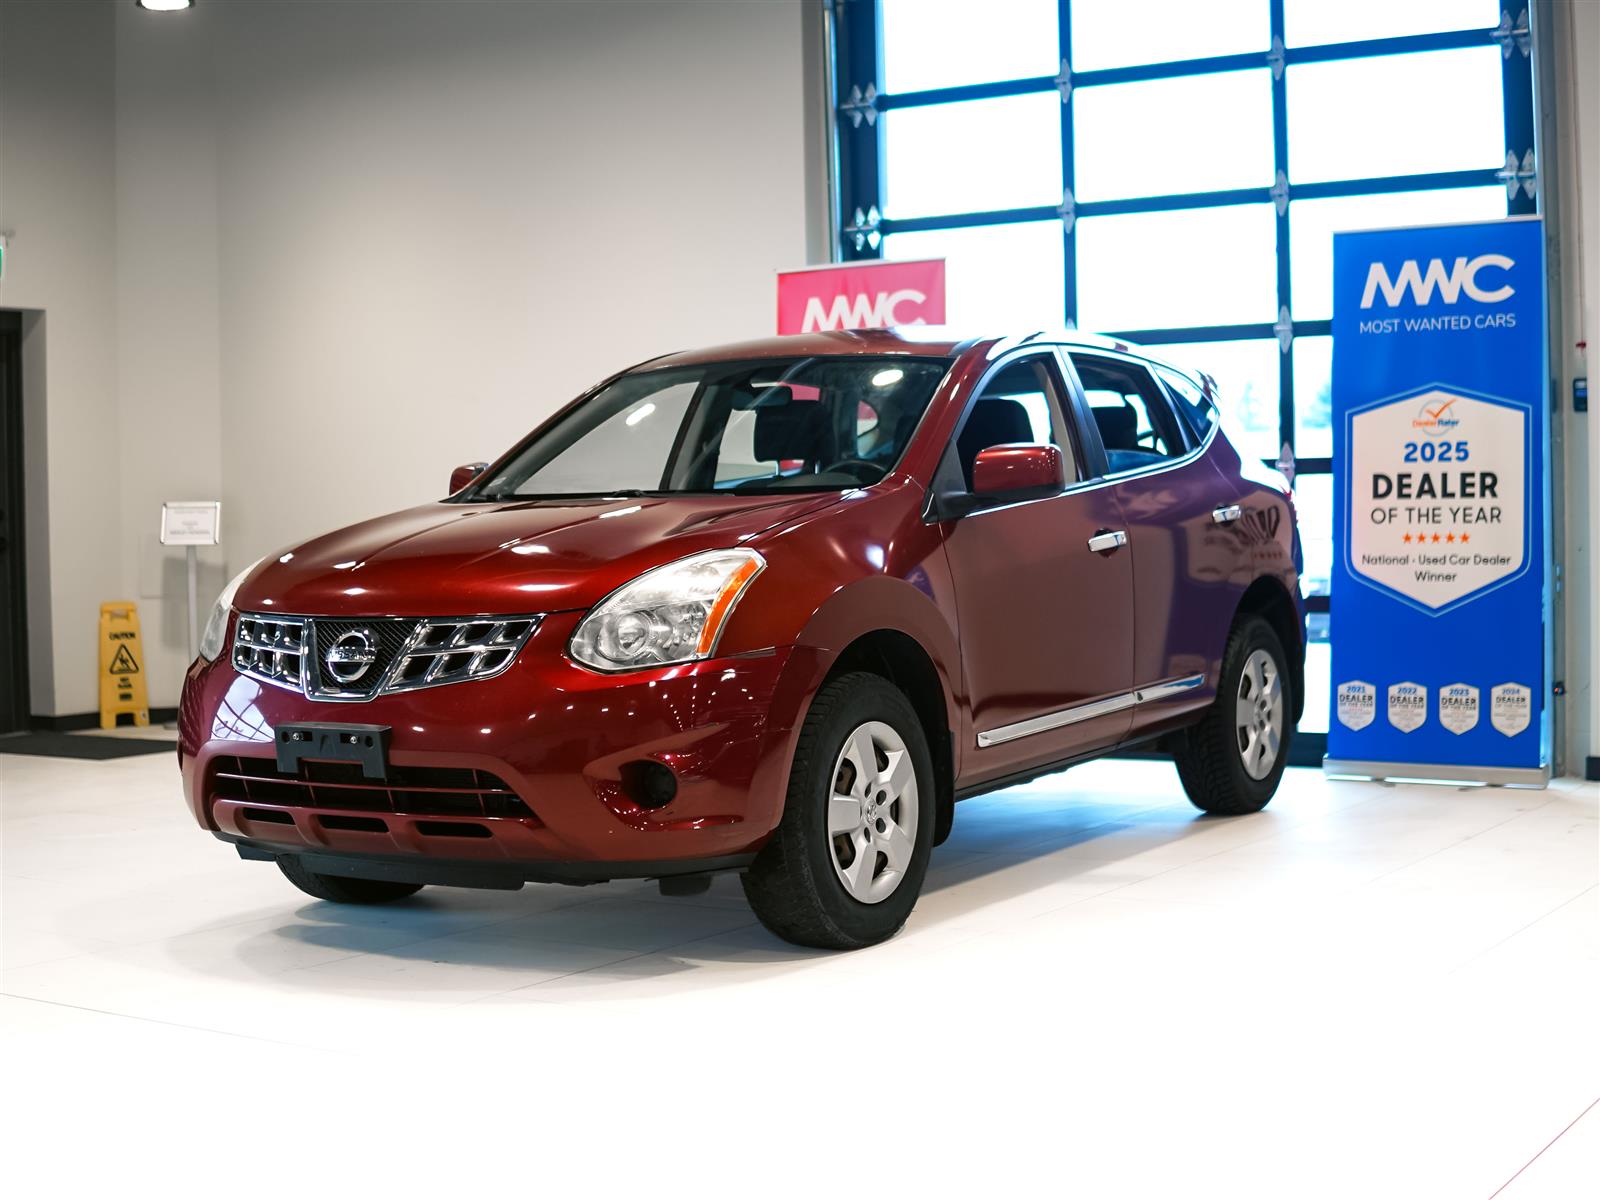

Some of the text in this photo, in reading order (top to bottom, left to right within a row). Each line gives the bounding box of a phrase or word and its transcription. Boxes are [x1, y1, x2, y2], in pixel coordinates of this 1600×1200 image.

[1360, 254, 1516, 309] MWC
[801, 289, 927, 334] MWC
[1360, 313, 1516, 334] MOST WANTED CARS
[1404, 441, 1470, 463] 2025
[1372, 472, 1498, 499] DEALER
[1371, 507, 1501, 524] OF THE YEAR
[1362, 554, 1409, 565] National
[1418, 555, 1446, 565] Used
[1449, 555, 1470, 565] Car
[1474, 554, 1511, 565] Dealer
[1415, 571, 1457, 582] Winner
[1340, 694, 1373, 703] DEALER
[1390, 695, 1424, 704] DEALER
[1441, 697, 1476, 705] DEALER
